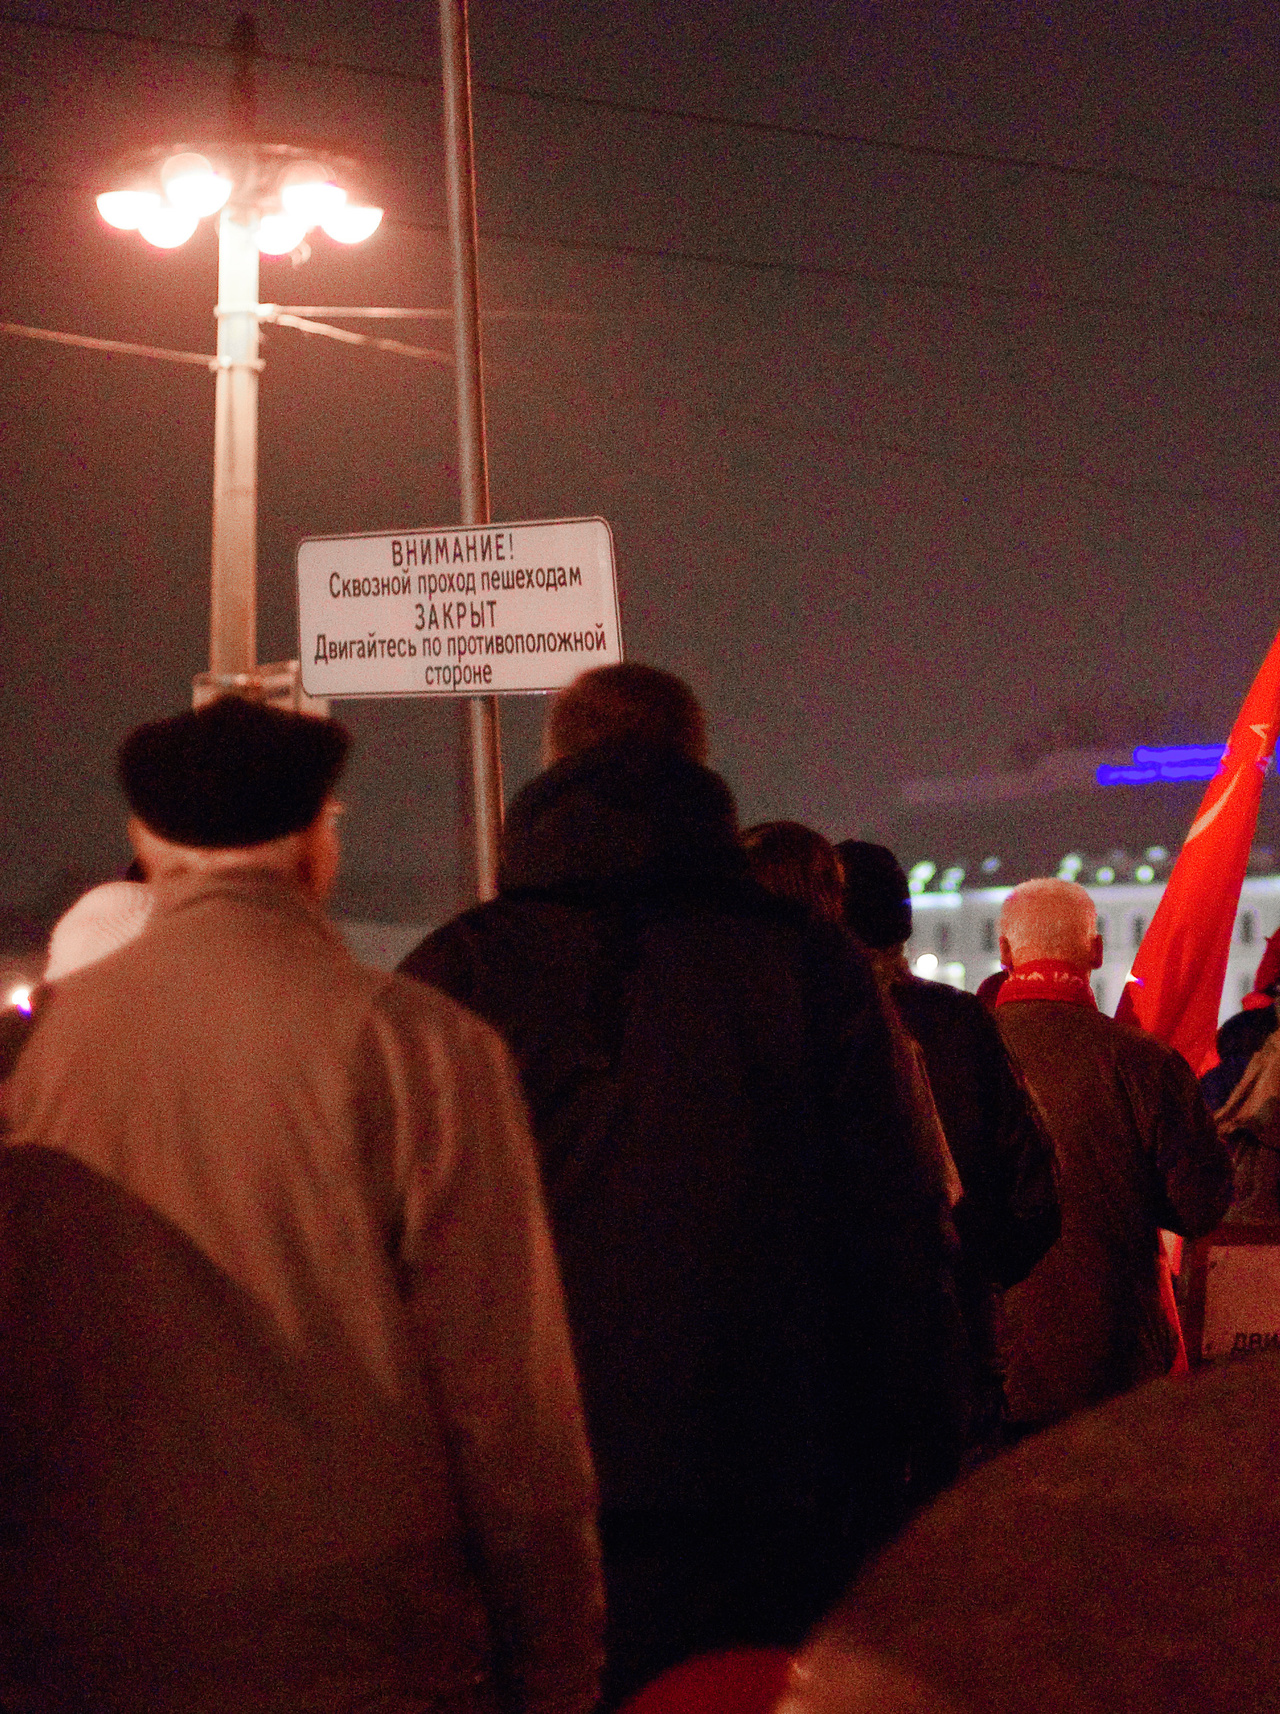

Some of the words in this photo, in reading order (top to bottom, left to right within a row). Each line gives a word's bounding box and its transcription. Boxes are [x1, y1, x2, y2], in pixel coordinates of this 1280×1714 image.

[391, 533, 515, 567] ВНИМАНИЕ!
[329, 567, 412, 598] Сквозной
[418, 573, 476, 600] проход
[481, 565, 582, 592] пешеходам
[414, 600, 497, 631] ЗАКРЫТ
[314, 632, 417, 664] Двигайтесь
[423, 636, 442, 658] по
[447, 623, 607, 662] противоположной
[424, 663, 493, 691] стороне
